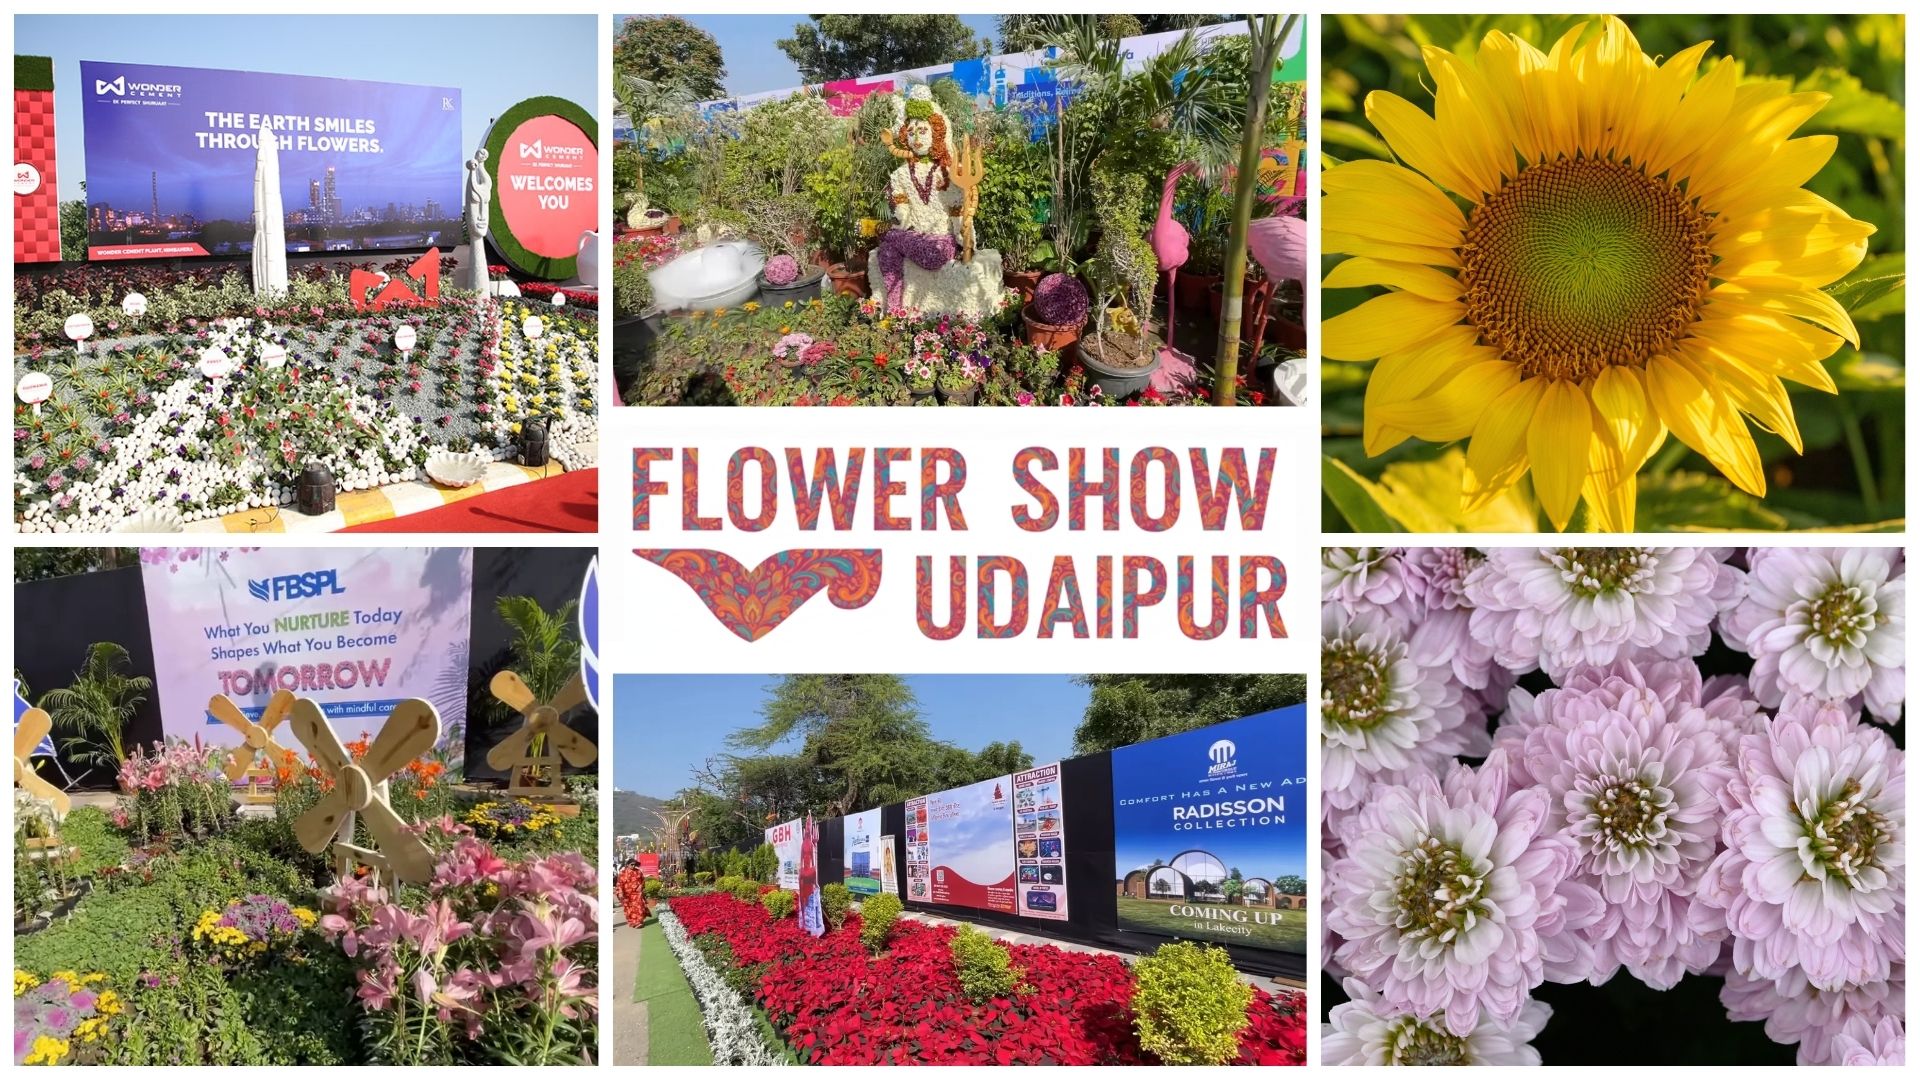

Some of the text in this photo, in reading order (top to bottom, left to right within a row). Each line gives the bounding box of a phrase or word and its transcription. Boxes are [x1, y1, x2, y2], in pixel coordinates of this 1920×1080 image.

[128, 82, 181, 93] WONDER
[205, 111, 375, 134] THE EARTH SMILES
[297, 136, 384, 153] FLOWERS.
[543, 146, 583, 155] WONDER
[510, 175, 594, 191] WELCOMES
[538, 195, 569, 210] YOU
[272, 568, 346, 602] FBSPL
[204, 607, 403, 639] What You NURTURE Today
[211, 634, 397, 661] Shapes What You Become
[217, 657, 392, 697] TOMORROW
[326, 704, 344, 714] with
[346, 702, 377, 713] mindful
[1016, 766, 1056, 784] ATTRACTION
[1207, 760, 1237, 775] MIRAJ
[1119, 794, 1175, 806] COMFORT
[1217, 786, 1228, 795] A
[1235, 781, 1272, 792] NEW
[1173, 796, 1285, 820] RADISSON
[1174, 815, 1285, 831] COLLECTION
[772, 825, 791, 844] GBH
[1169, 904, 1283, 925] COMING UP
[1194, 920, 1252, 937] in Lakecity
